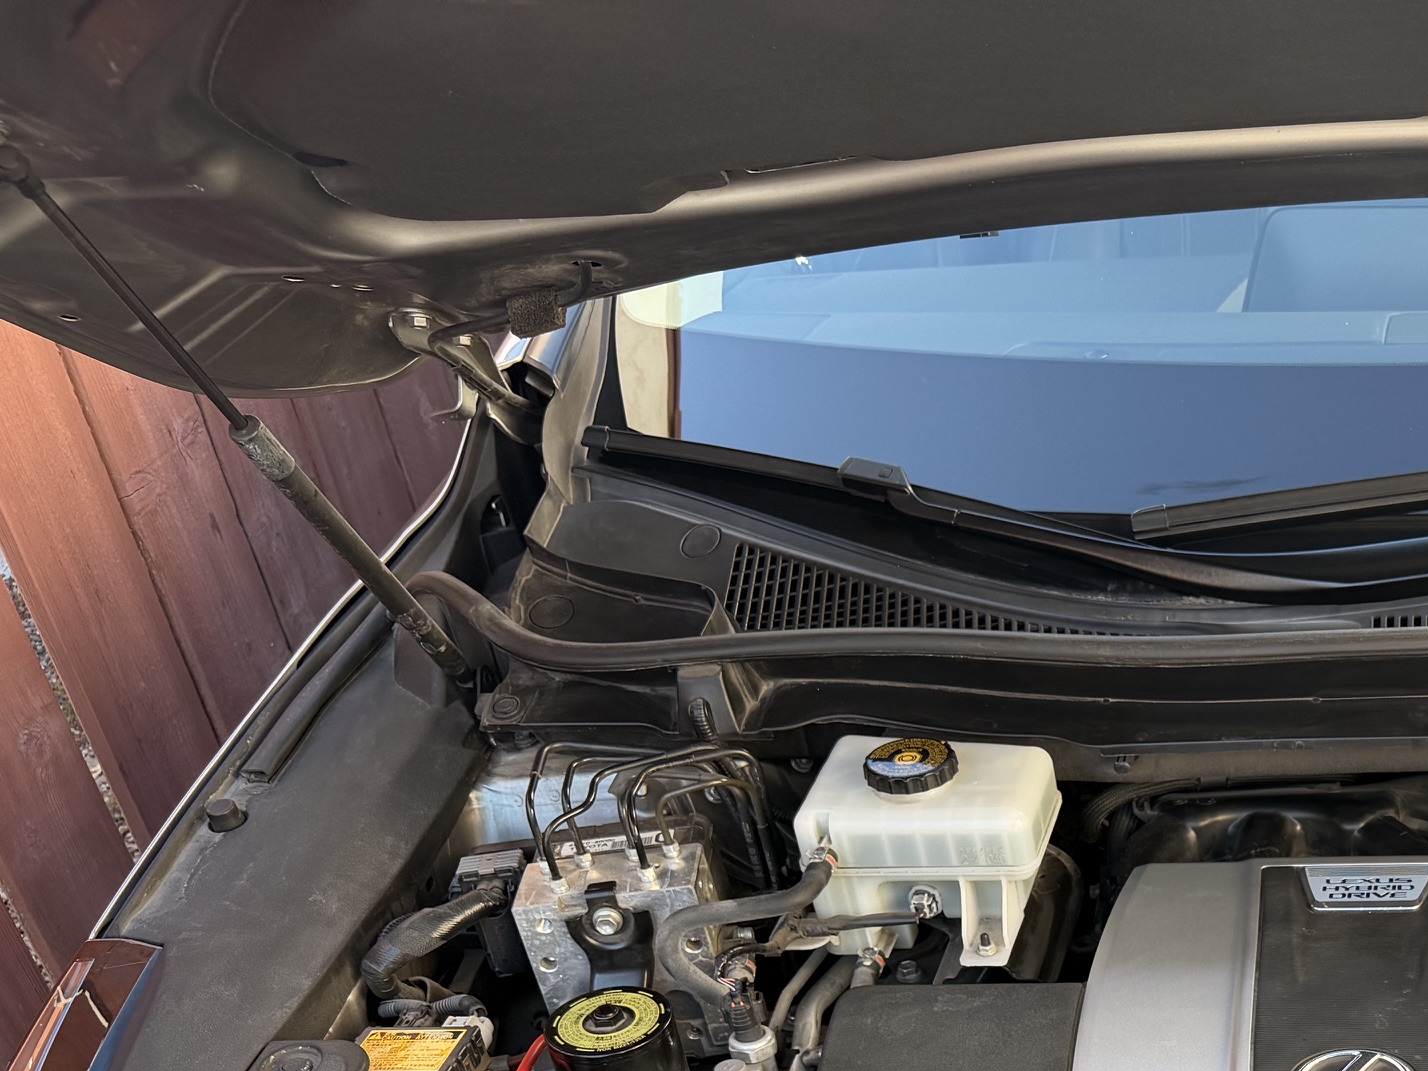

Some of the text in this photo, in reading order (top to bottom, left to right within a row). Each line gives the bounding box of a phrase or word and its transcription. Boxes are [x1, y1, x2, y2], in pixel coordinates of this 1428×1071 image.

[1325, 877, 1413, 885] LEXUS
[1321, 884, 1415, 893] HYBRID
[1328, 891, 1408, 900] DRIVE
